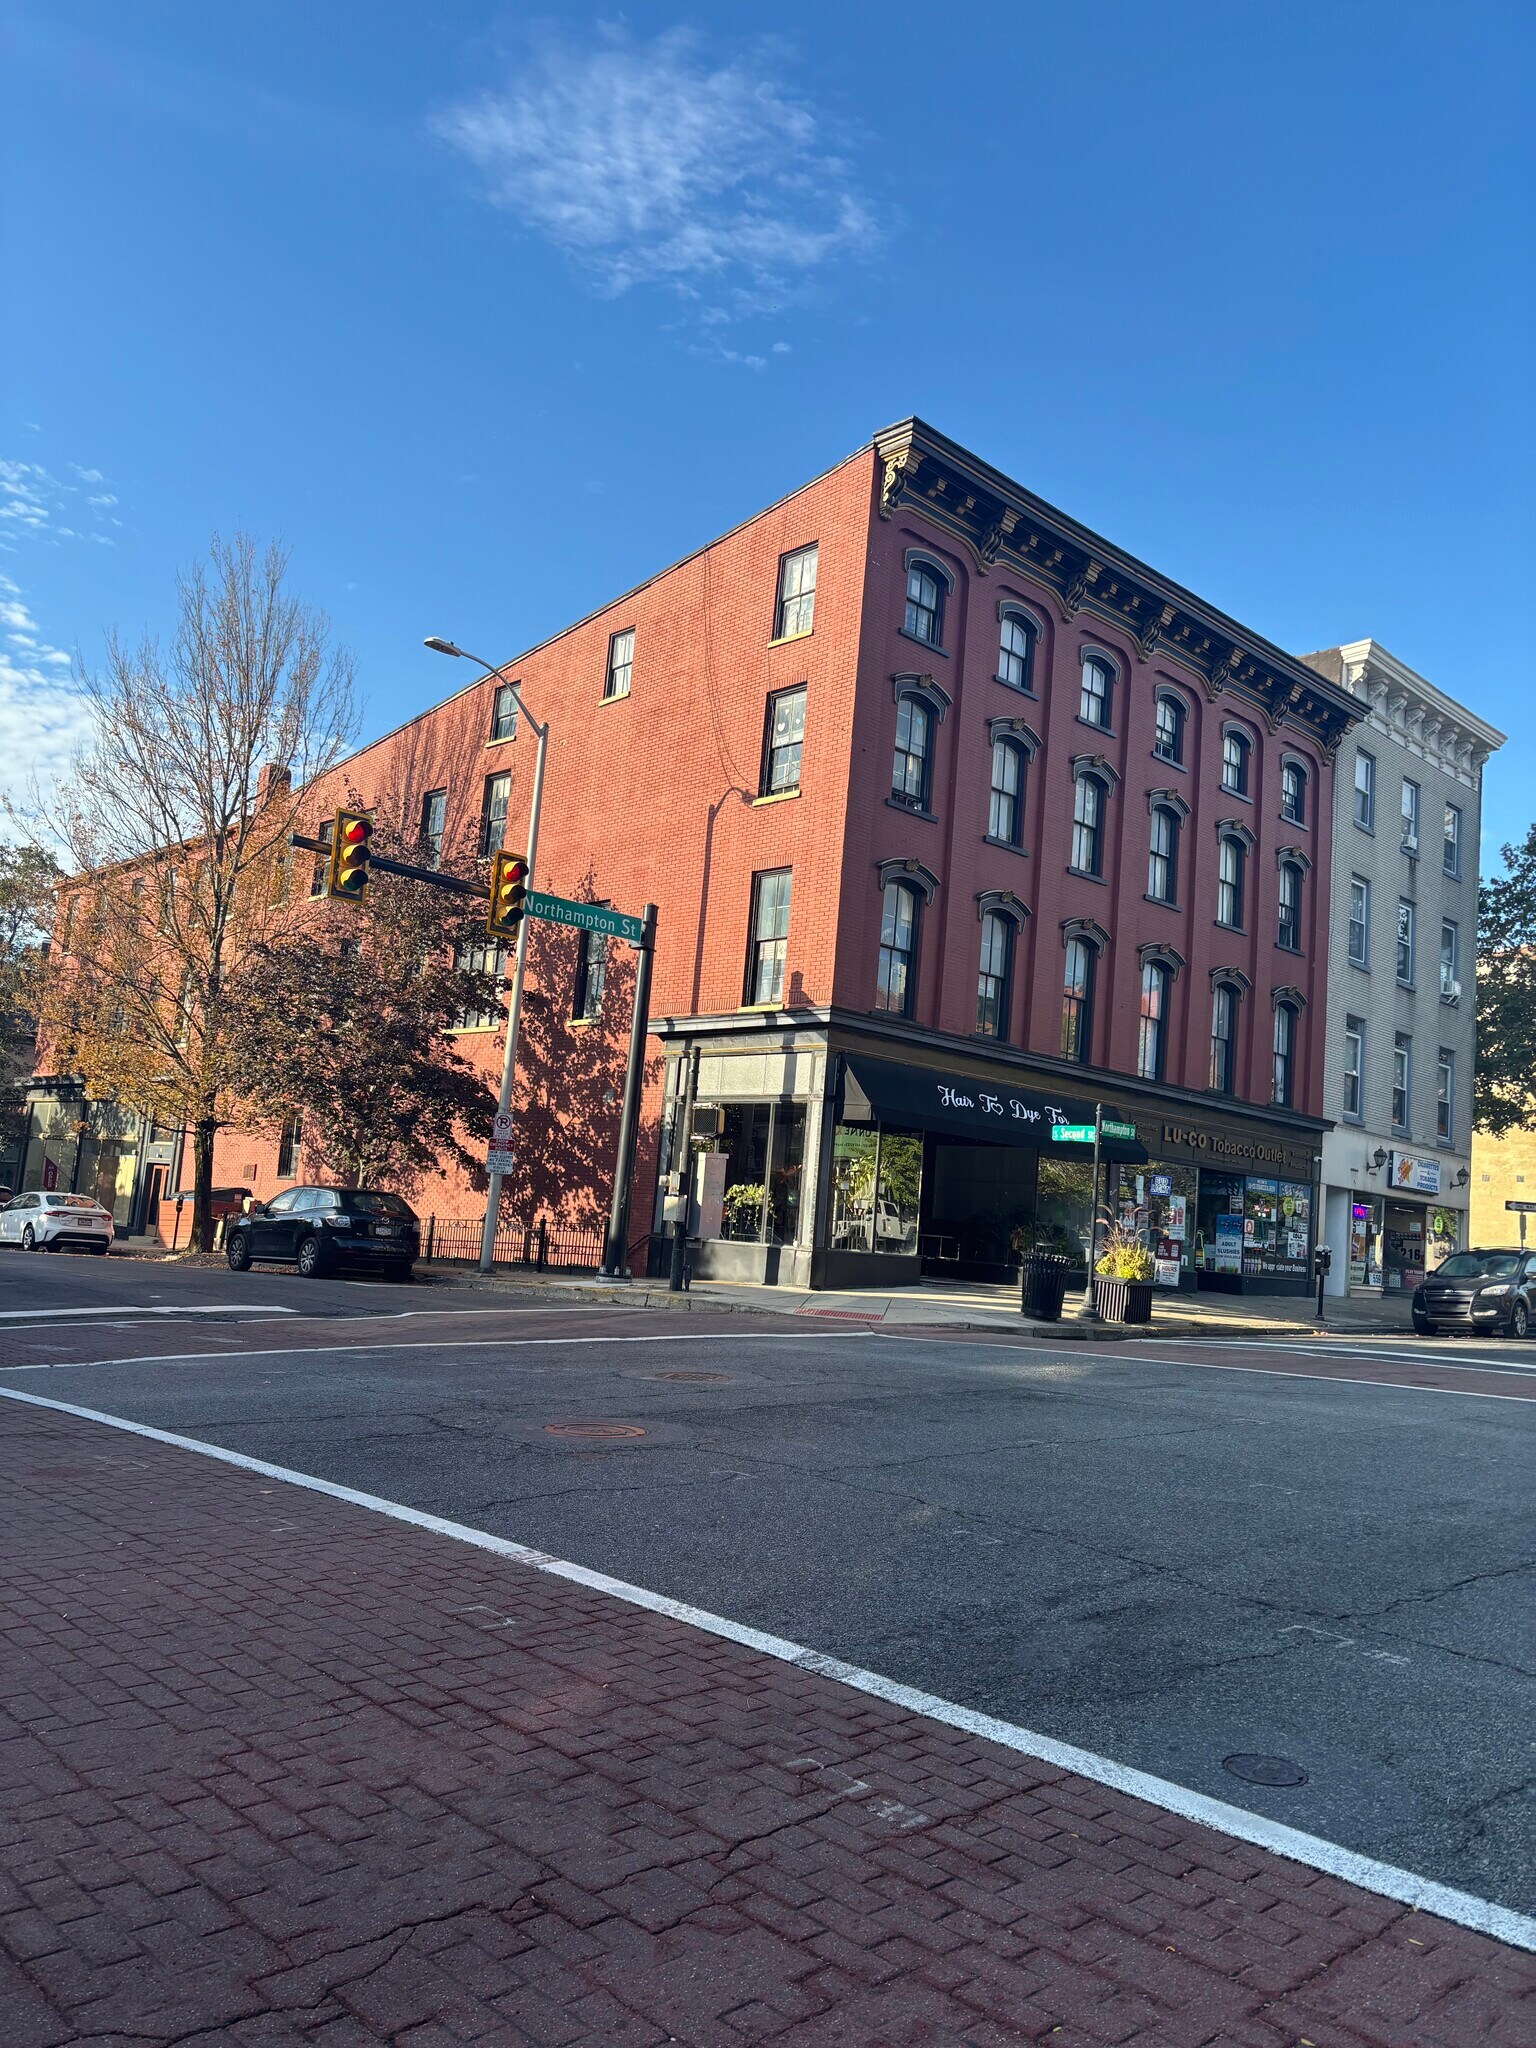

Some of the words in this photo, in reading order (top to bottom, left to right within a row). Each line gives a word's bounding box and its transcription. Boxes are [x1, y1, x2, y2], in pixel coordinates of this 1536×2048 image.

[523, 892, 615, 928] Northampton
[621, 918, 637, 937] St
[937, 1085, 975, 1108] Hair
[1009, 1099, 1041, 1123] Dye
[1044, 1105, 1070, 1125] For
[1060, 1127, 1086, 1140] Second
[1101, 1121, 1130, 1136] Northampton
[1164, 1125, 1207, 1149] LU-CO
[1211, 1136, 1255, 1158] Tobacco
[1257, 1145, 1287, 1163] Outlet
[1416, 1181, 1439, 1192] PRODUCTS
[1262, 1261, 1268, 1270] We
[1267, 1262, 1285, 1272] apprciate
[1284, 1264, 1293, 1273] your
[1292, 1263, 1307, 1273] Business
